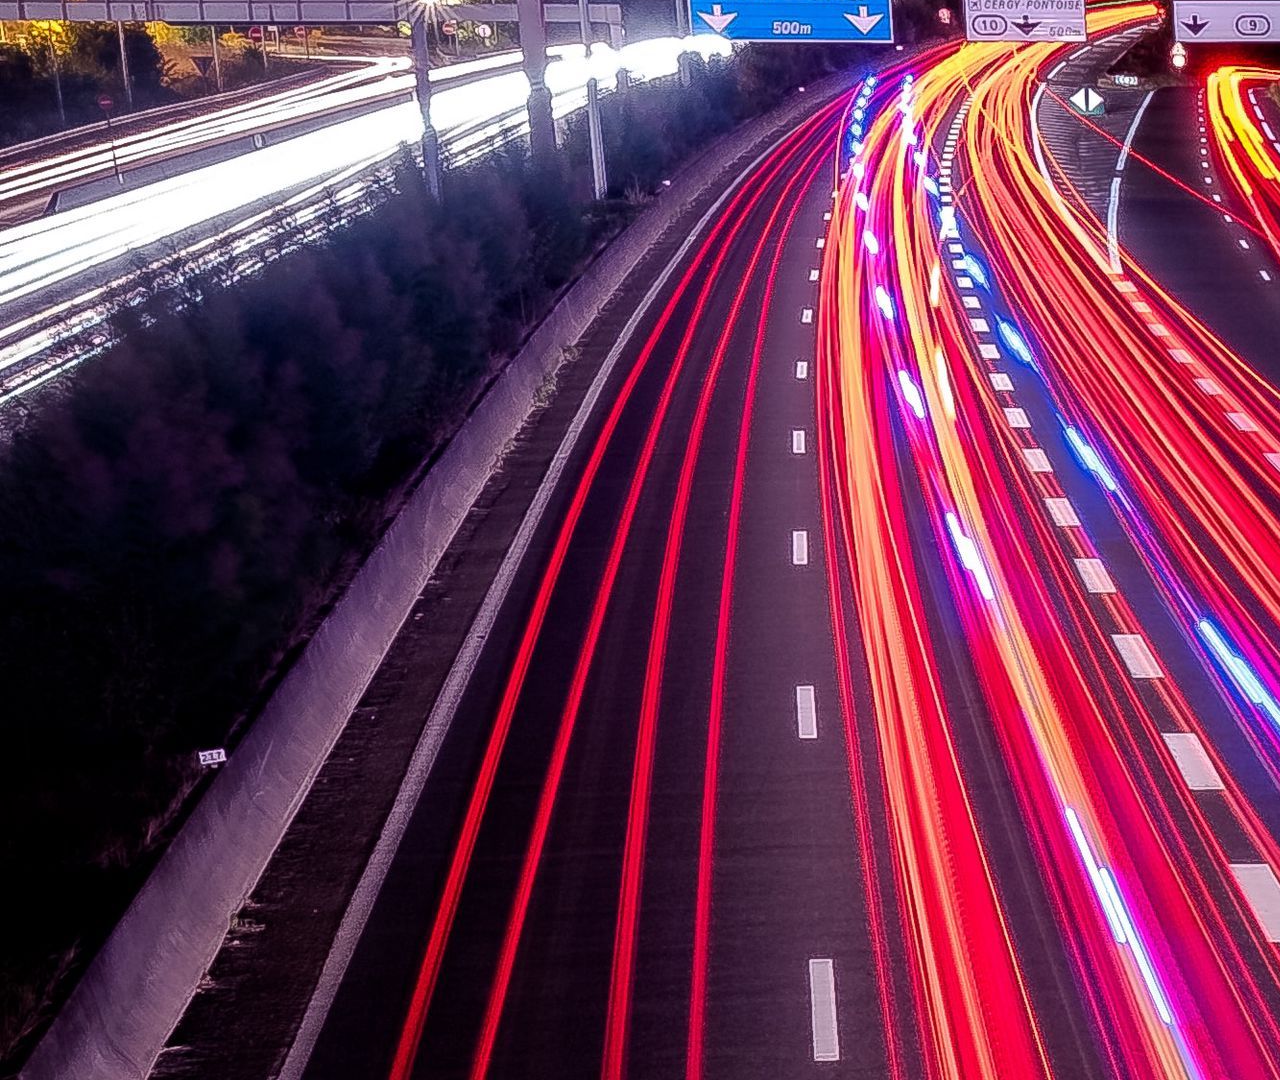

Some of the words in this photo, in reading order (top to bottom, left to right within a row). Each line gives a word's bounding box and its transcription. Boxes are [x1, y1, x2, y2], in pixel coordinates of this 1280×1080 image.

[772, 22, 812, 34] 500m
[982, 20, 998, 31] 10
[1249, 20, 1257, 31] 9
